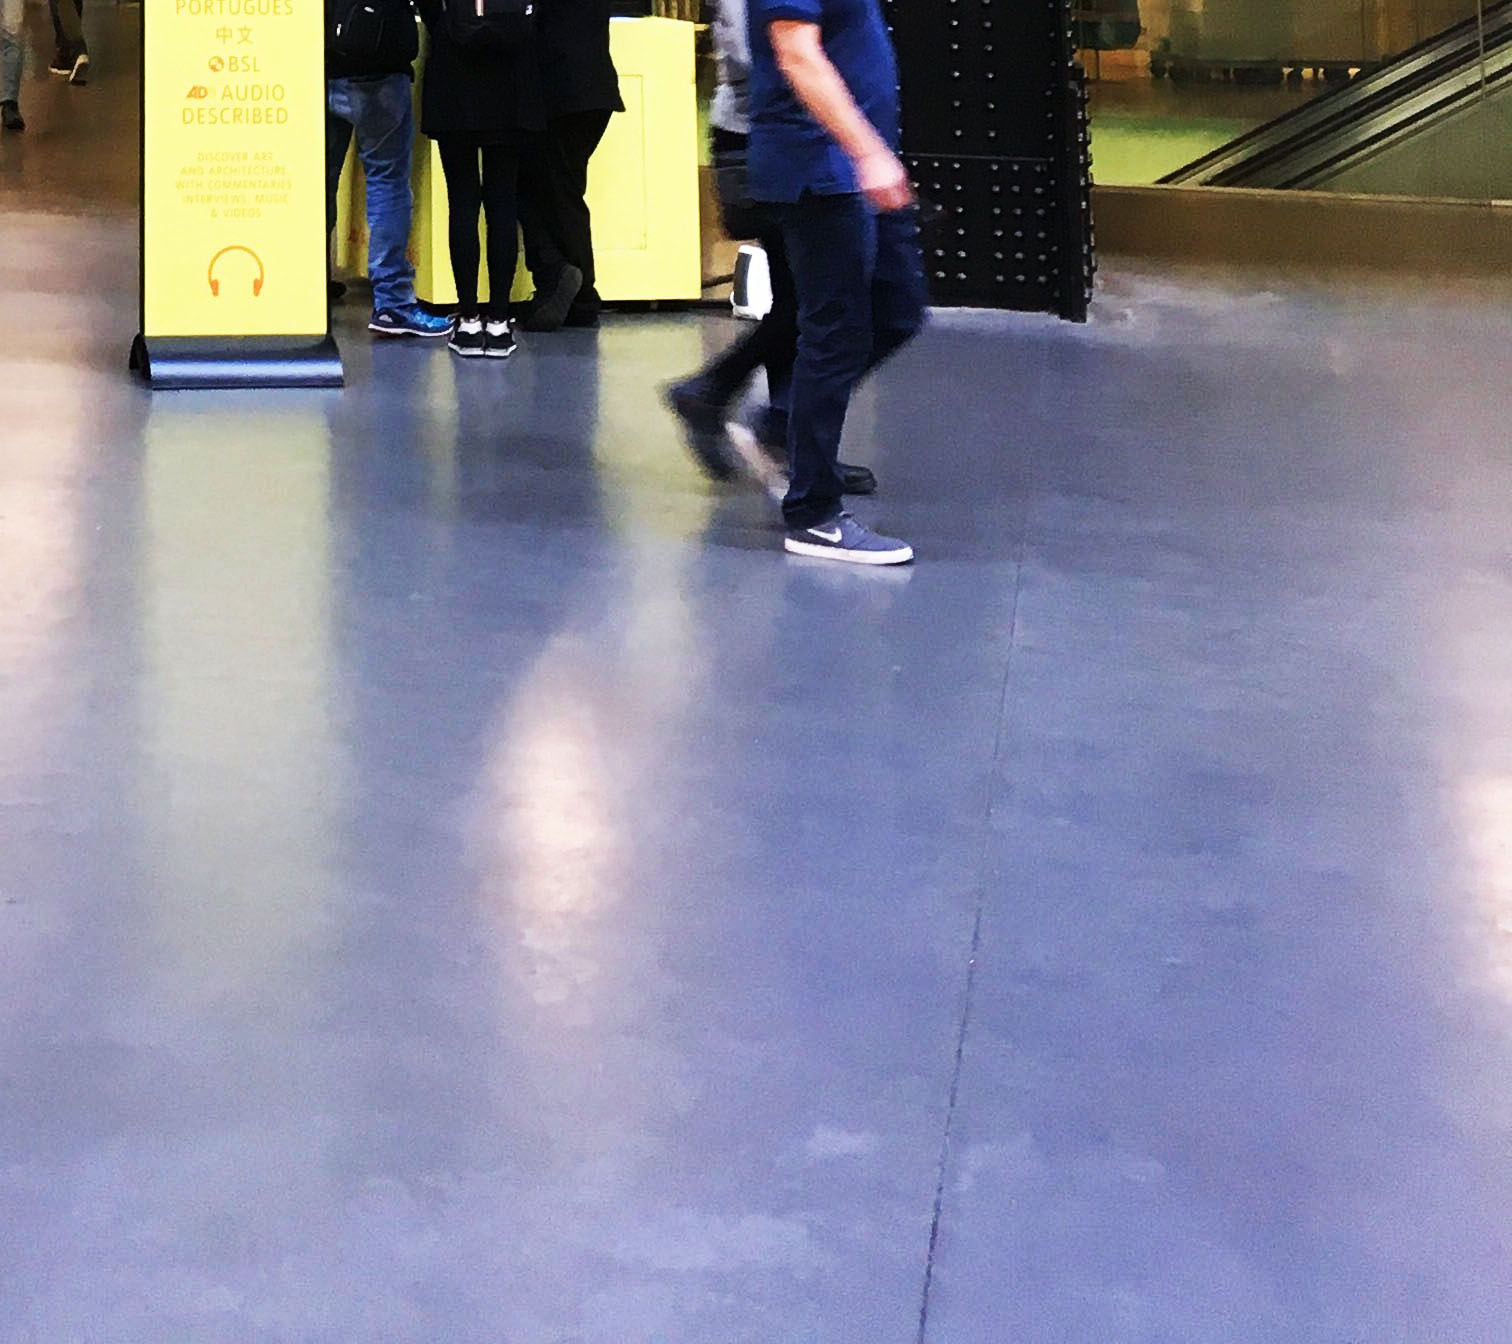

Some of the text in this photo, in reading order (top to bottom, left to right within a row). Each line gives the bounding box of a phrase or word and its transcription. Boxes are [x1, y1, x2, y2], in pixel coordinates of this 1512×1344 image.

[215, 25, 254, 45] 中文
[228, 55, 260, 74] BSL
[221, 83, 285, 102] AUDIO
[182, 106, 288, 125] DESCRIBED
